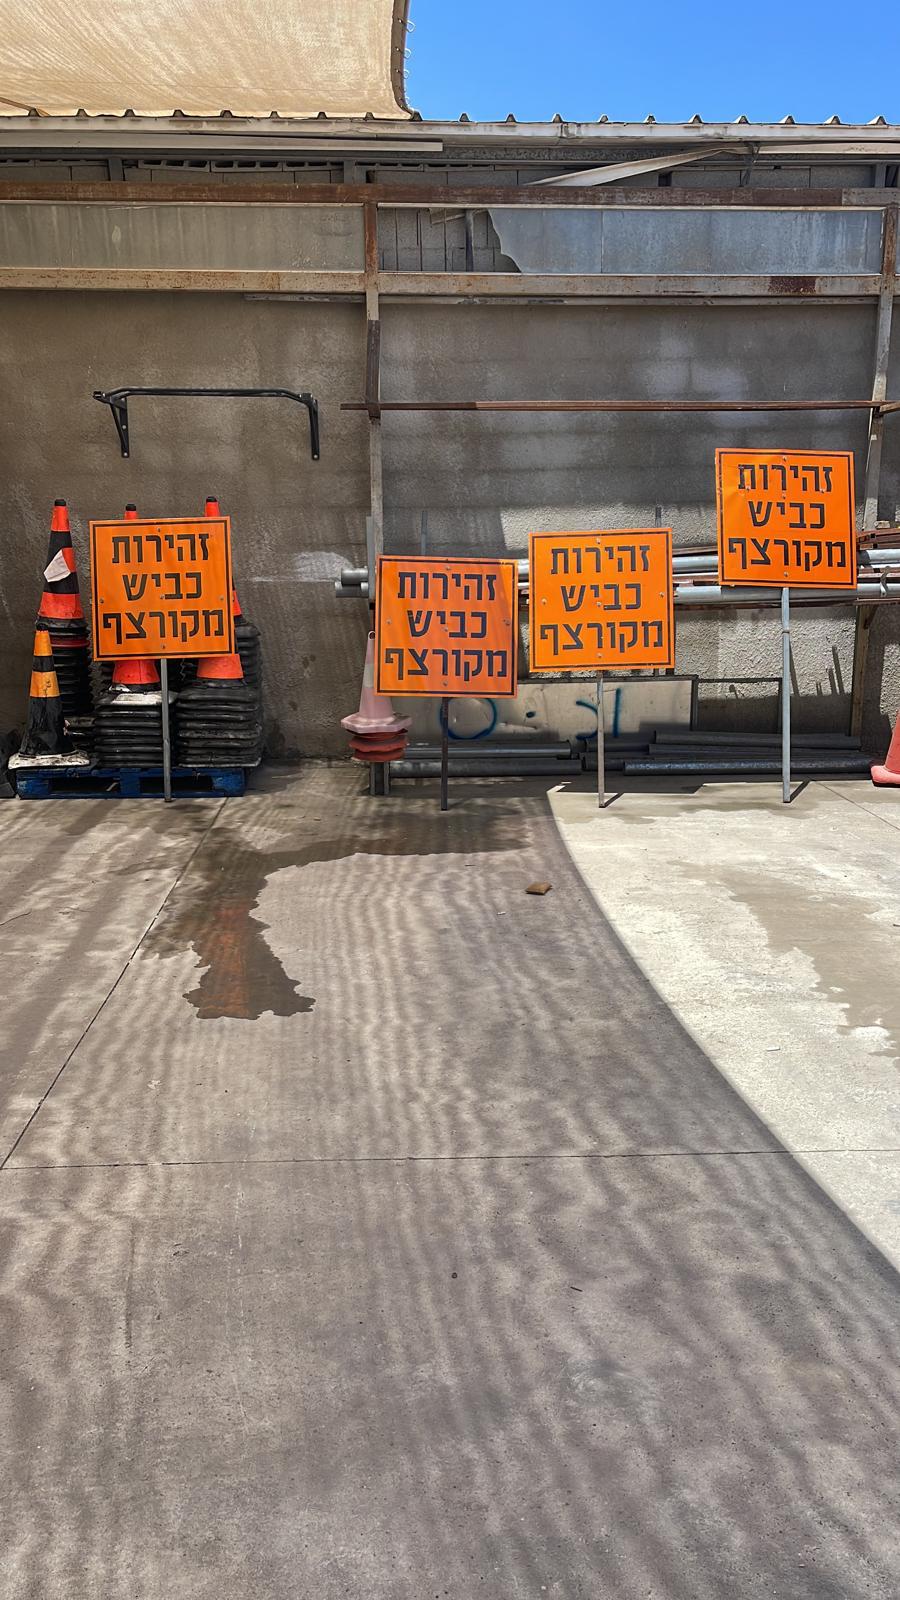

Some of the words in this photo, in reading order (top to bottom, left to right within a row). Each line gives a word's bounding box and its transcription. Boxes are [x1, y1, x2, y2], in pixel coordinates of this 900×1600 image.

[737, 464, 833, 492] זהירות
[748, 500, 826, 529] כביש
[111, 533, 209, 564] זהירות
[550, 545, 651, 575] זהירות
[728, 537, 847, 572] מקורצף
[122, 571, 202, 601] כביש
[397, 571, 497, 601] זהירות
[560, 583, 642, 612] כביש
[102, 609, 225, 645] מקורצף
[406, 610, 488, 639] כביש
[539, 620, 663, 656] מקורצף
[384, 647, 508, 682] מקורצף
